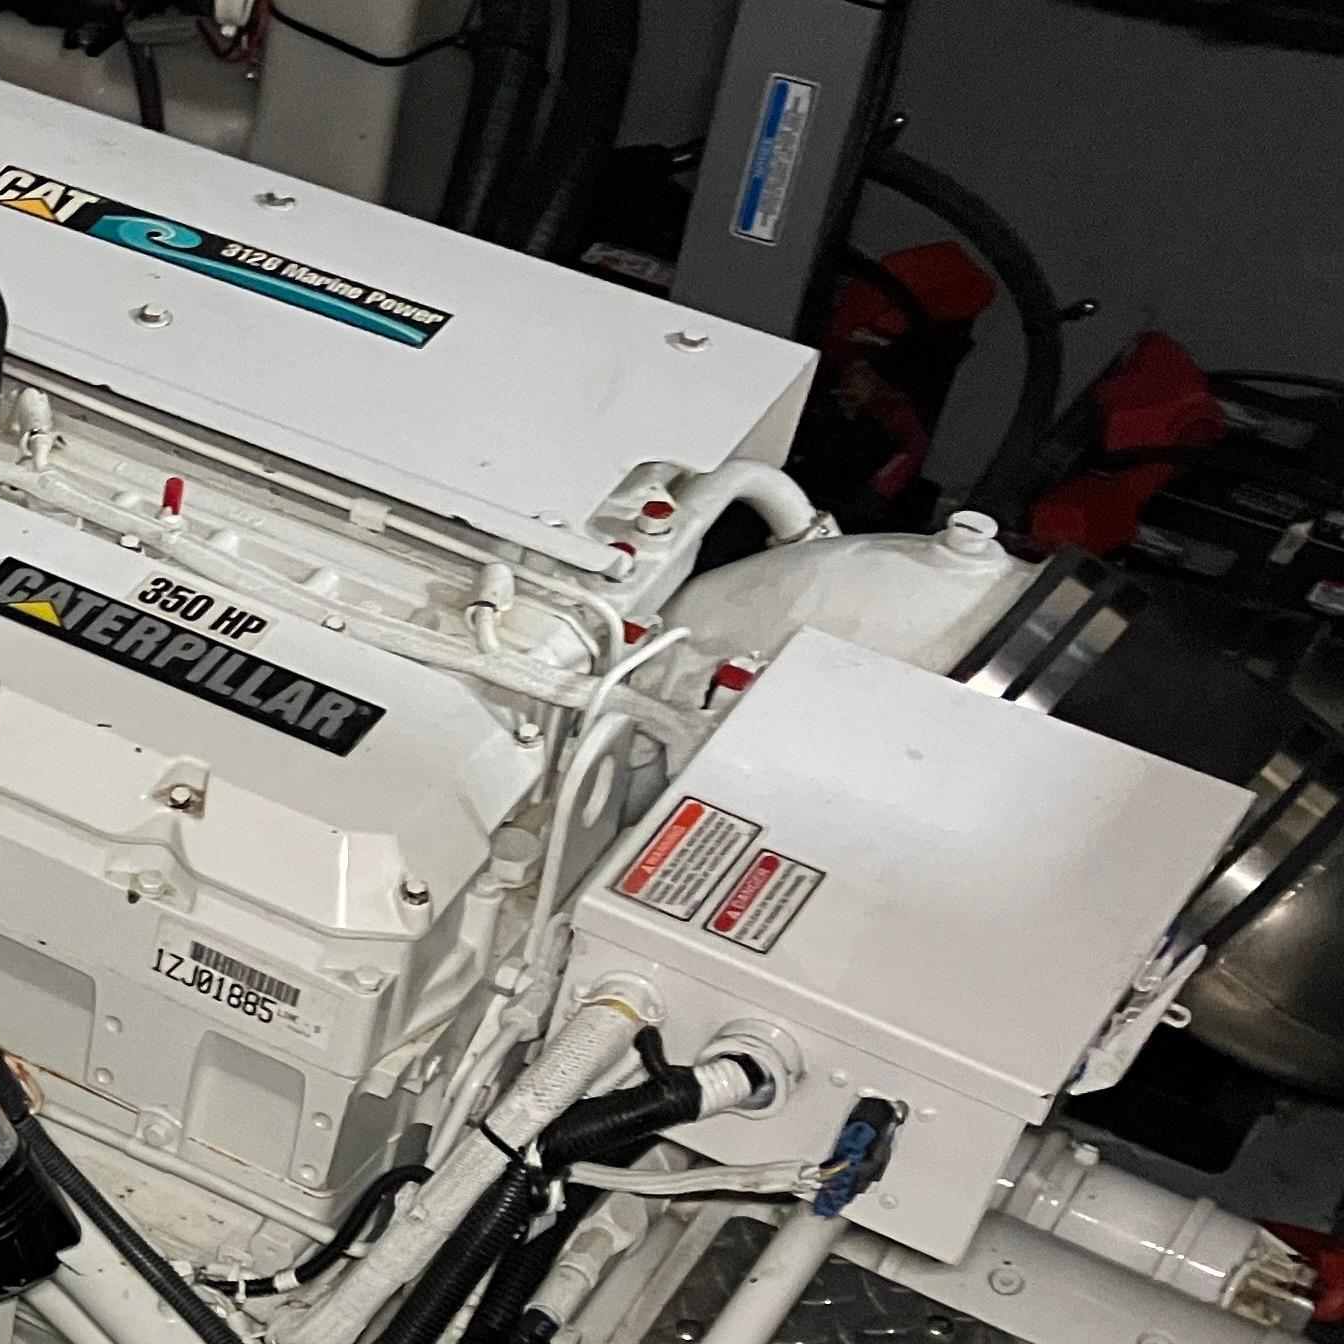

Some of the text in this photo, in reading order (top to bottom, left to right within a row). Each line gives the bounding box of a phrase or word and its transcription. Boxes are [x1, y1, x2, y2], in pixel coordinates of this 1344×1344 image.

[281, 263, 364, 300] Marine
[365, 290, 443, 325] Power
[138, 577, 268, 641] 350 HP
[152, 948, 278, 1023] 1ZJ01885
